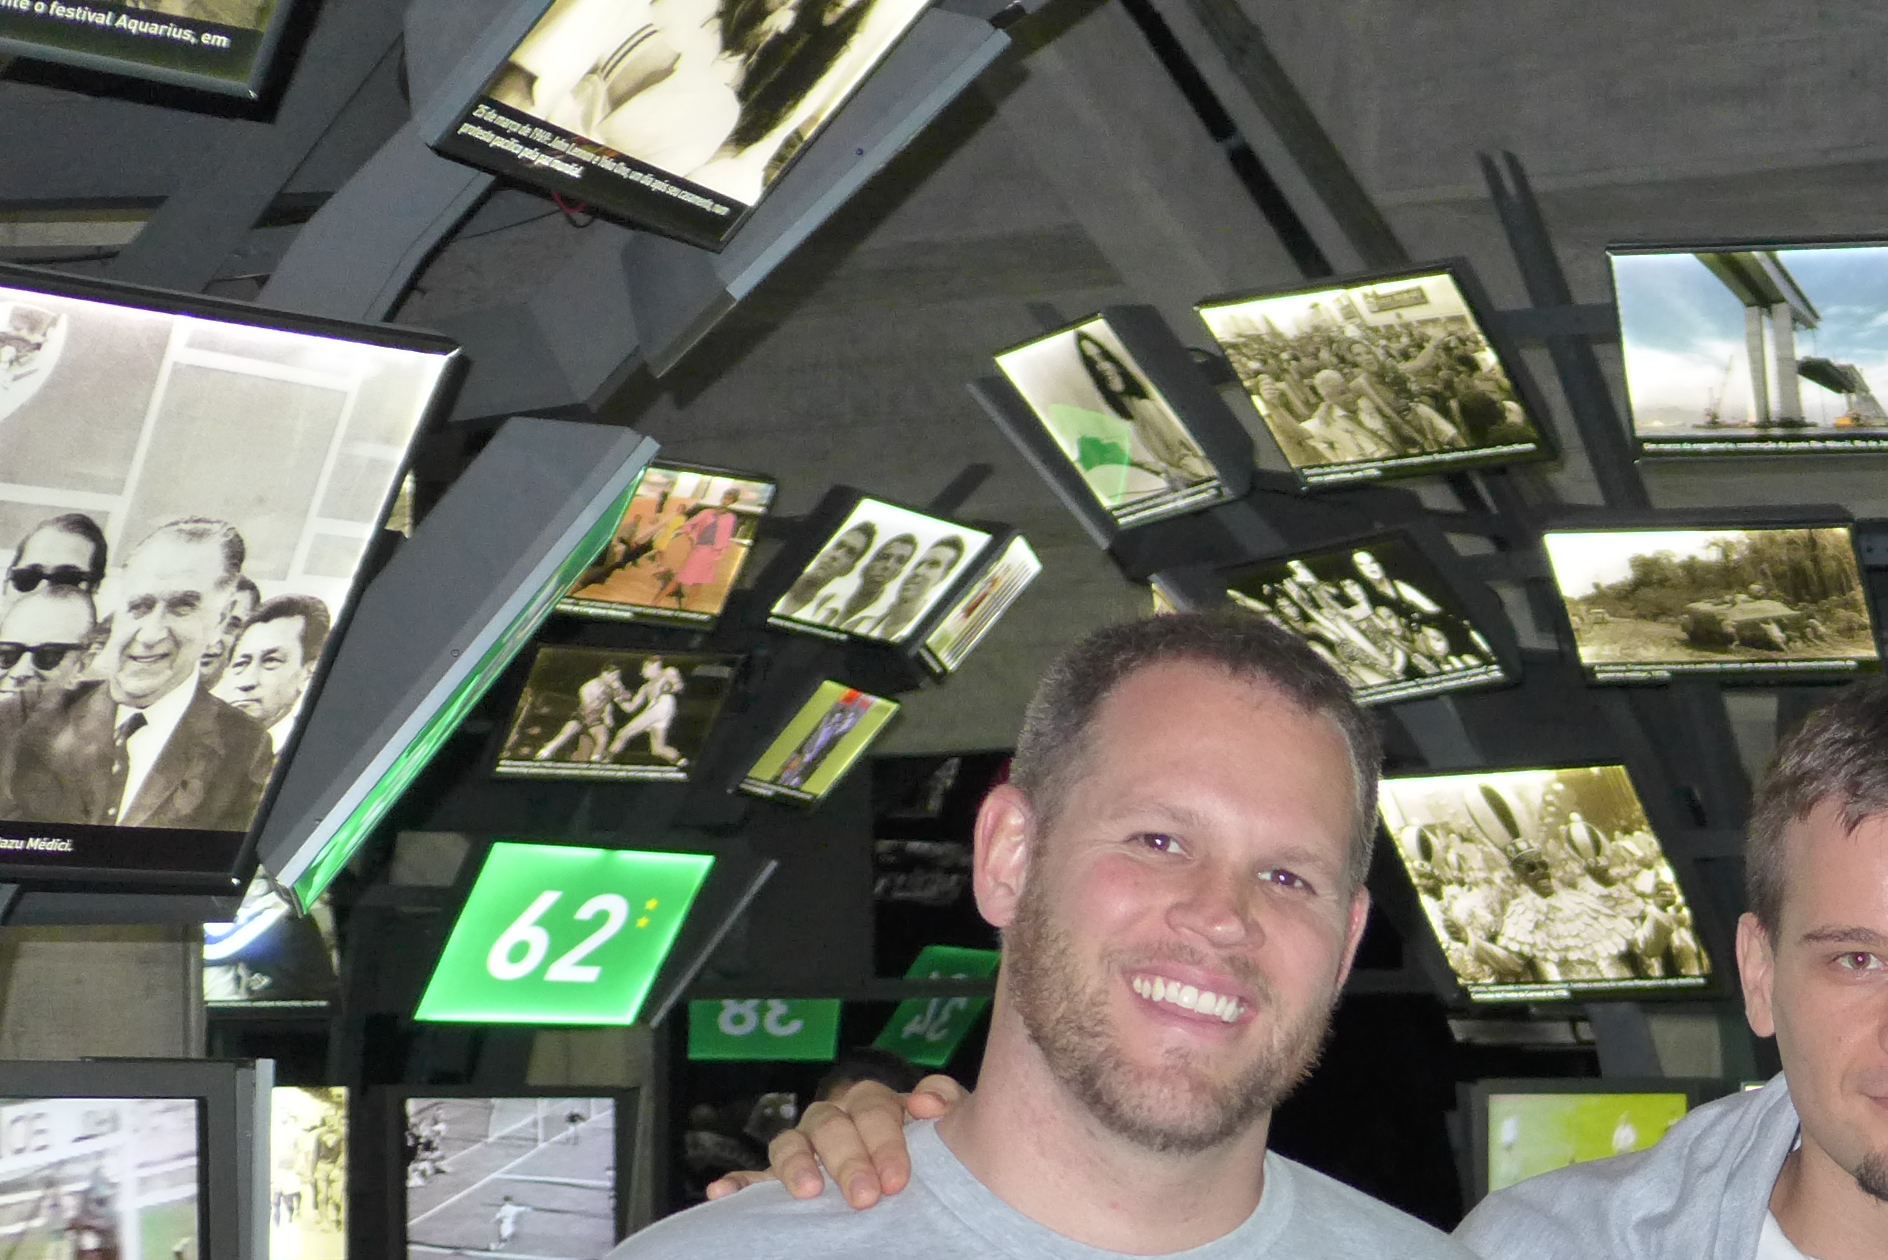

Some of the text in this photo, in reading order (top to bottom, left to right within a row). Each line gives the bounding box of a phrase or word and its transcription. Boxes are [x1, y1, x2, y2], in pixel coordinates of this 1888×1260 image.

[34, 1, 48, 13] o
[49, 1, 113, 27] festival
[114, 14, 199, 44] Aquarius,
[201, 33, 231, 48] em
[0, 837, 75, 852] azu Médici.
[486, 889, 630, 982] 62
